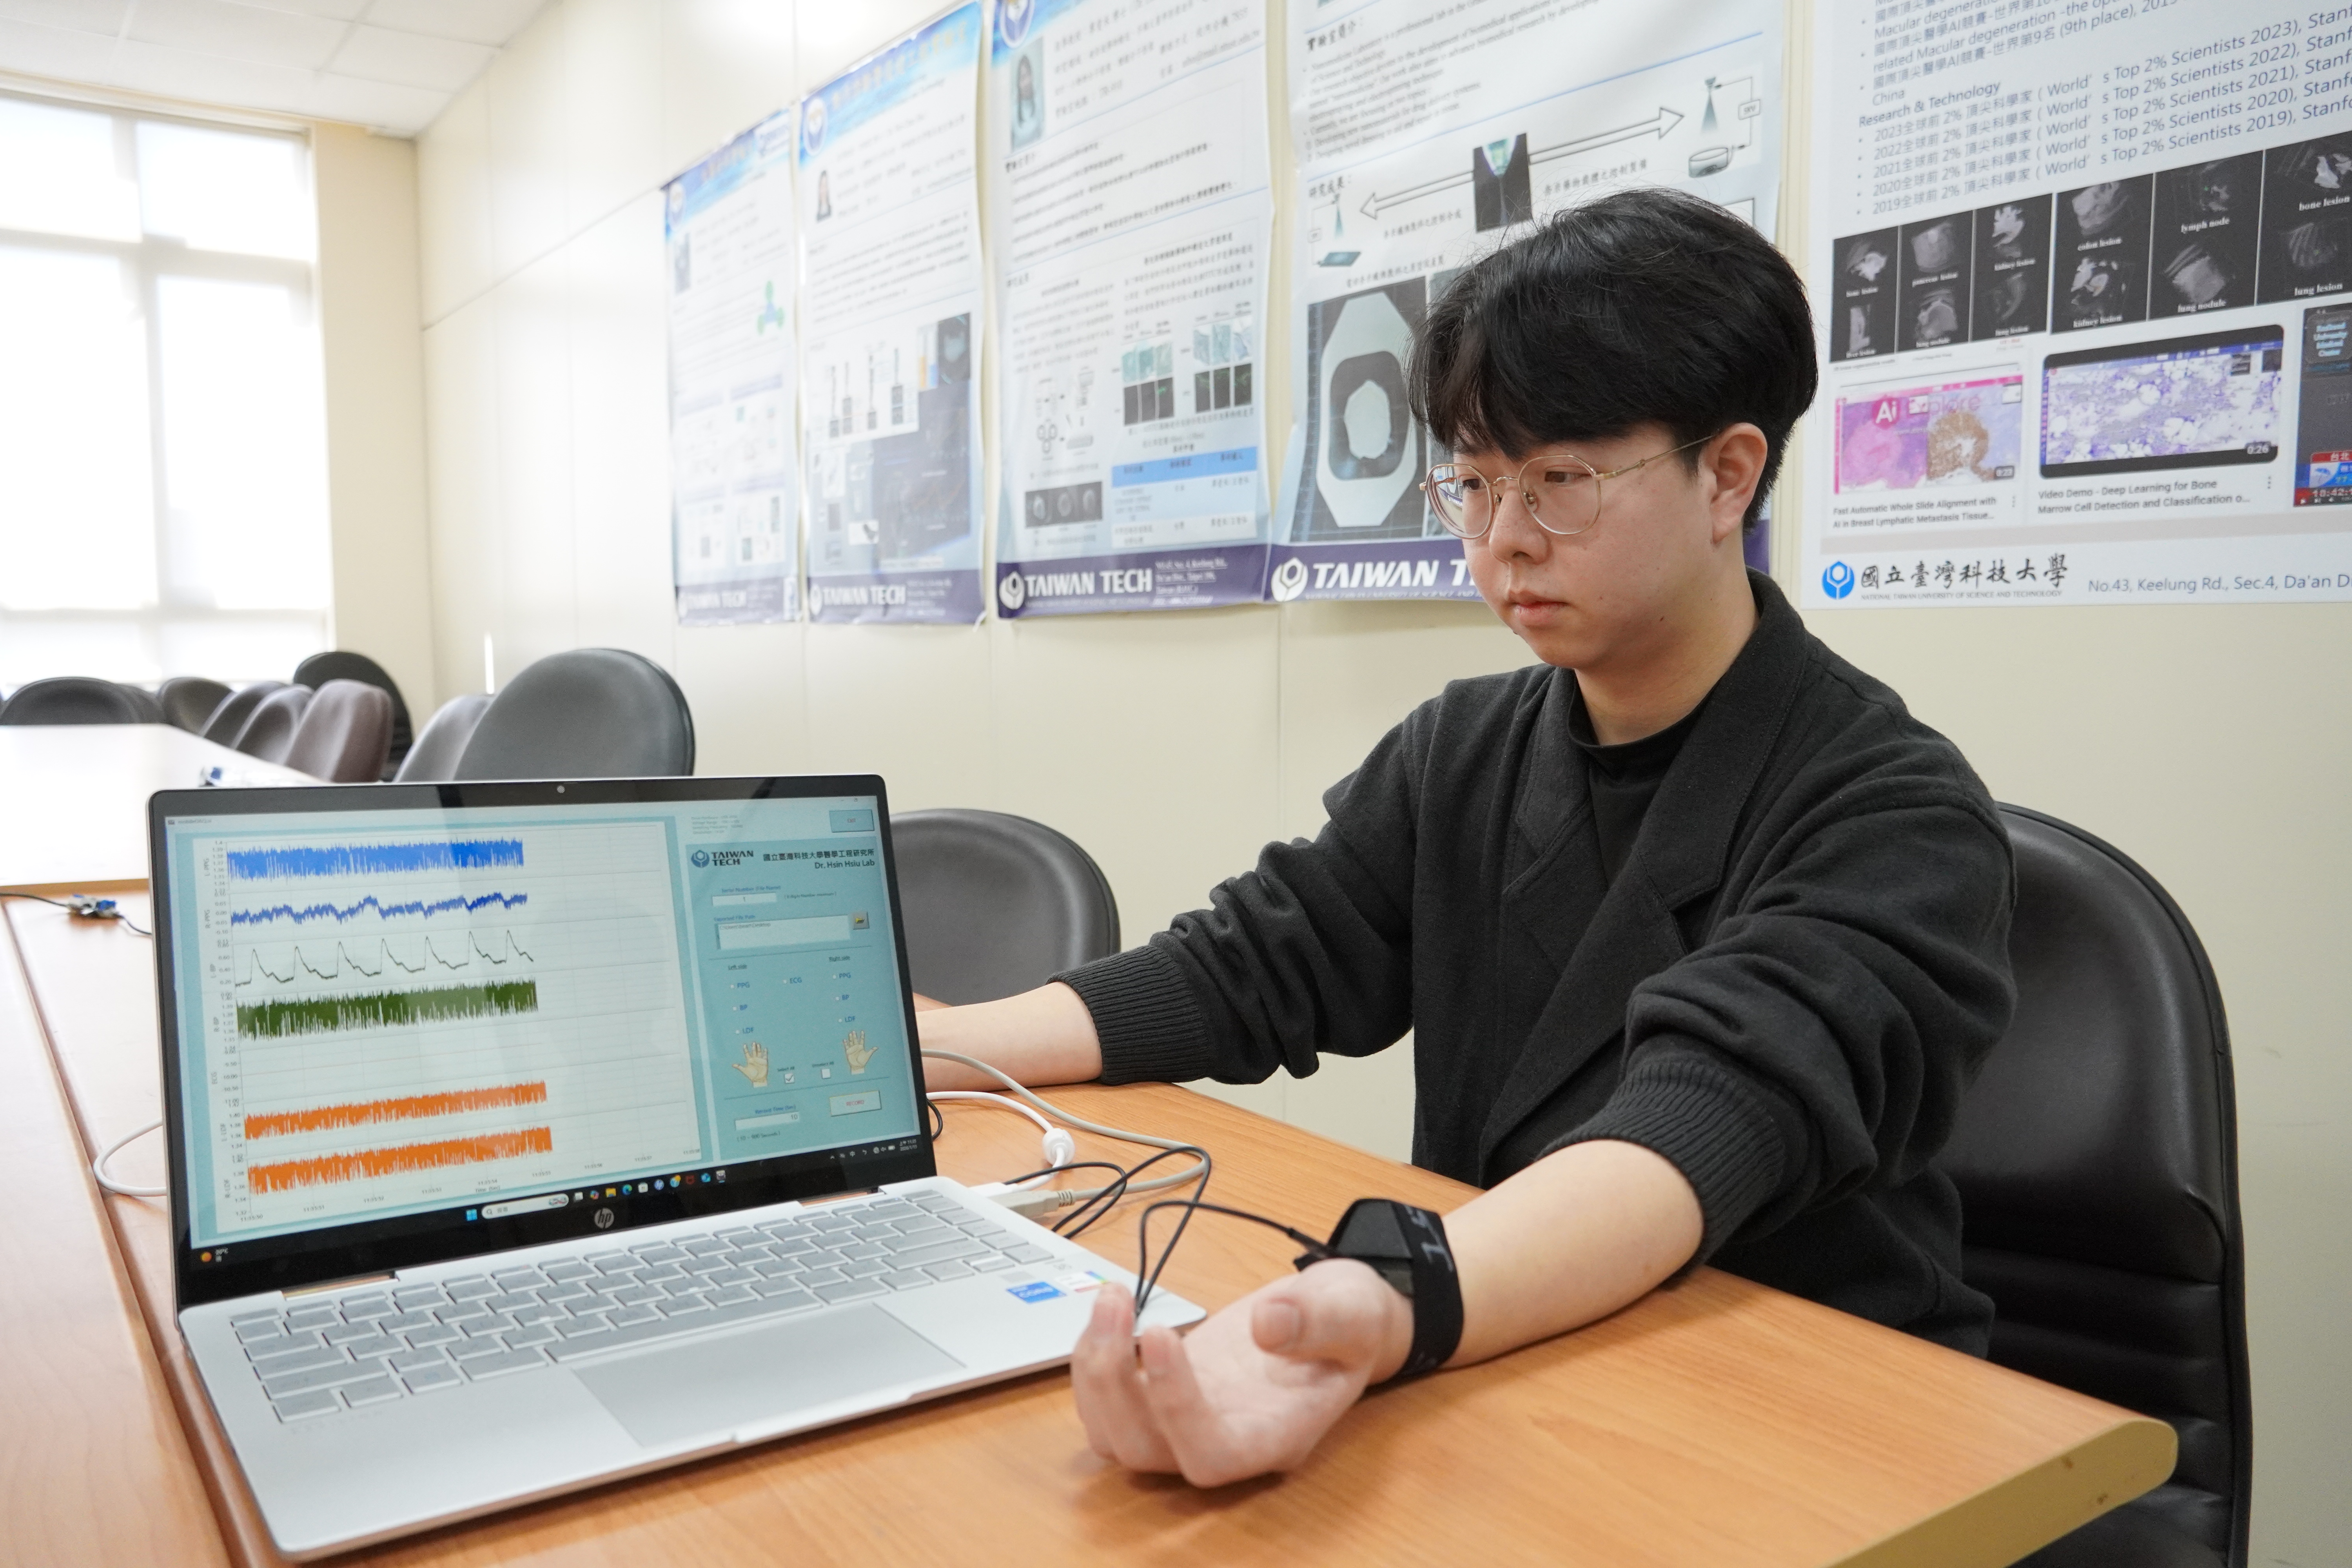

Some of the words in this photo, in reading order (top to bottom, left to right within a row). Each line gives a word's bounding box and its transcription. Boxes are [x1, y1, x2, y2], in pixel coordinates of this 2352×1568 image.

[2060, 18, 2087, 38] (9th
[2091, 4, 2136, 31] place),
[1873, 51, 1913, 73] related
[1916, 38, 1965, 58] Macular
[1968, 11, 2056, 45] degeneration
[1875, 114, 1940, 142] 2023全球前
[1943, 109, 1962, 124] 2%
[1965, 90, 2033, 119] 頂尖科學家
[2114, 65, 2140, 79] Top
[2144, 56, 2167, 73] 2%
[2172, 37, 2245, 65] Scientists
[2250, 19, 2301, 45] 2023),
[1859, 104, 1911, 128] Research
[1914, 100, 1925, 113] &
[1929, 82, 2001, 109] Technology
[1873, 89, 1905, 106] China
[1874, 133, 1939, 160] 2022全球前
[1942, 127, 1961, 143] 2%
[1965, 110, 2032, 138] 頂尖科學家
[2113, 86, 2139, 100] Top
[2143, 76, 2166, 93] 2%
[2171, 58, 2243, 87] Scientists
[2249, 42, 2300, 67] 2022),
[1873, 152, 1938, 178] 2021全球前
[1942, 147, 1961, 162] 2%
[1965, 129, 2031, 157] 頂尖科學家
[2113, 106, 2138, 121] Top
[2143, 98, 2165, 114] 2%
[2170, 81, 2243, 108] Scientists
[2248, 65, 2299, 89] 2021),
[1873, 171, 1938, 196] 2020全球前
[1942, 166, 1960, 181] 2%
[1964, 149, 2031, 176] 頂尖科學家
[2112, 127, 2138, 142] Top
[2142, 118, 2164, 135] 2%
[2169, 103, 2241, 129] Scientists
[2247, 88, 2297, 111] 2020),
[1873, 190, 1937, 214] 2019全球前
[1941, 184, 1960, 199] 2%
[1964, 168, 2030, 196] 頂尖科學家
[2112, 147, 2137, 162] Top
[2141, 139, 2164, 156] 2%
[2169, 123, 2241, 150] Scientists
[2246, 110, 2296, 133] 2019),
[2320, 195, 2350, 208] lesion
[2317, 282, 2343, 293] lesion
[1875, 401, 1897, 424] Ai
[2247, 445, 2269, 454] 0:26
[2038, 490, 2063, 499] Video
[2066, 488, 2093, 497] Demo
[2102, 486, 2125, 497] Deep
[2129, 483, 2171, 495] Learning
[2174, 481, 2188, 491] for
[2191, 479, 2217, 490] Bone
[1850, 505, 1888, 514] Automatic
[1890, 503, 1913, 512] Whole
[1915, 501, 1934, 510] Slide
[1936, 499, 1977, 510] Alignment
[1979, 497, 1996, 506] with
[2038, 505, 2071, 514] Marrow
[2074, 503, 2091, 512] Cell
[2094, 500, 2140, 511] Detection
[2142, 498, 2161, 509] and
[2163, 495, 2232, 508] Classification
[1851, 519, 1874, 528] Breast
[1876, 516, 1914, 528] Lymphatic
[1916, 513, 1959, 523] Metastasis
[1313, 559, 1439, 589] TAIWAN
[1861, 553, 2068, 589] 國立臺灣科技大學
[1024, 571, 1095, 597] TAIWAN
[1099, 568, 1153, 595] TECH
[2088, 579, 2132, 593] No.43,
[2138, 577, 2196, 594] Keelung
[2202, 577, 2229, 591] Rd.,
[2234, 575, 2278, 590] Sec.4,
[2283, 574, 2331, 588] Da'an
[822, 586, 869, 607] TAIWAN
[871, 586, 906, 605] TECH
[711, 850, 754, 859] TAIWAN
[712, 858, 741, 867] TECH
[763, 849, 875, 862] 國立臺灣科技大學醫學工程研究所
